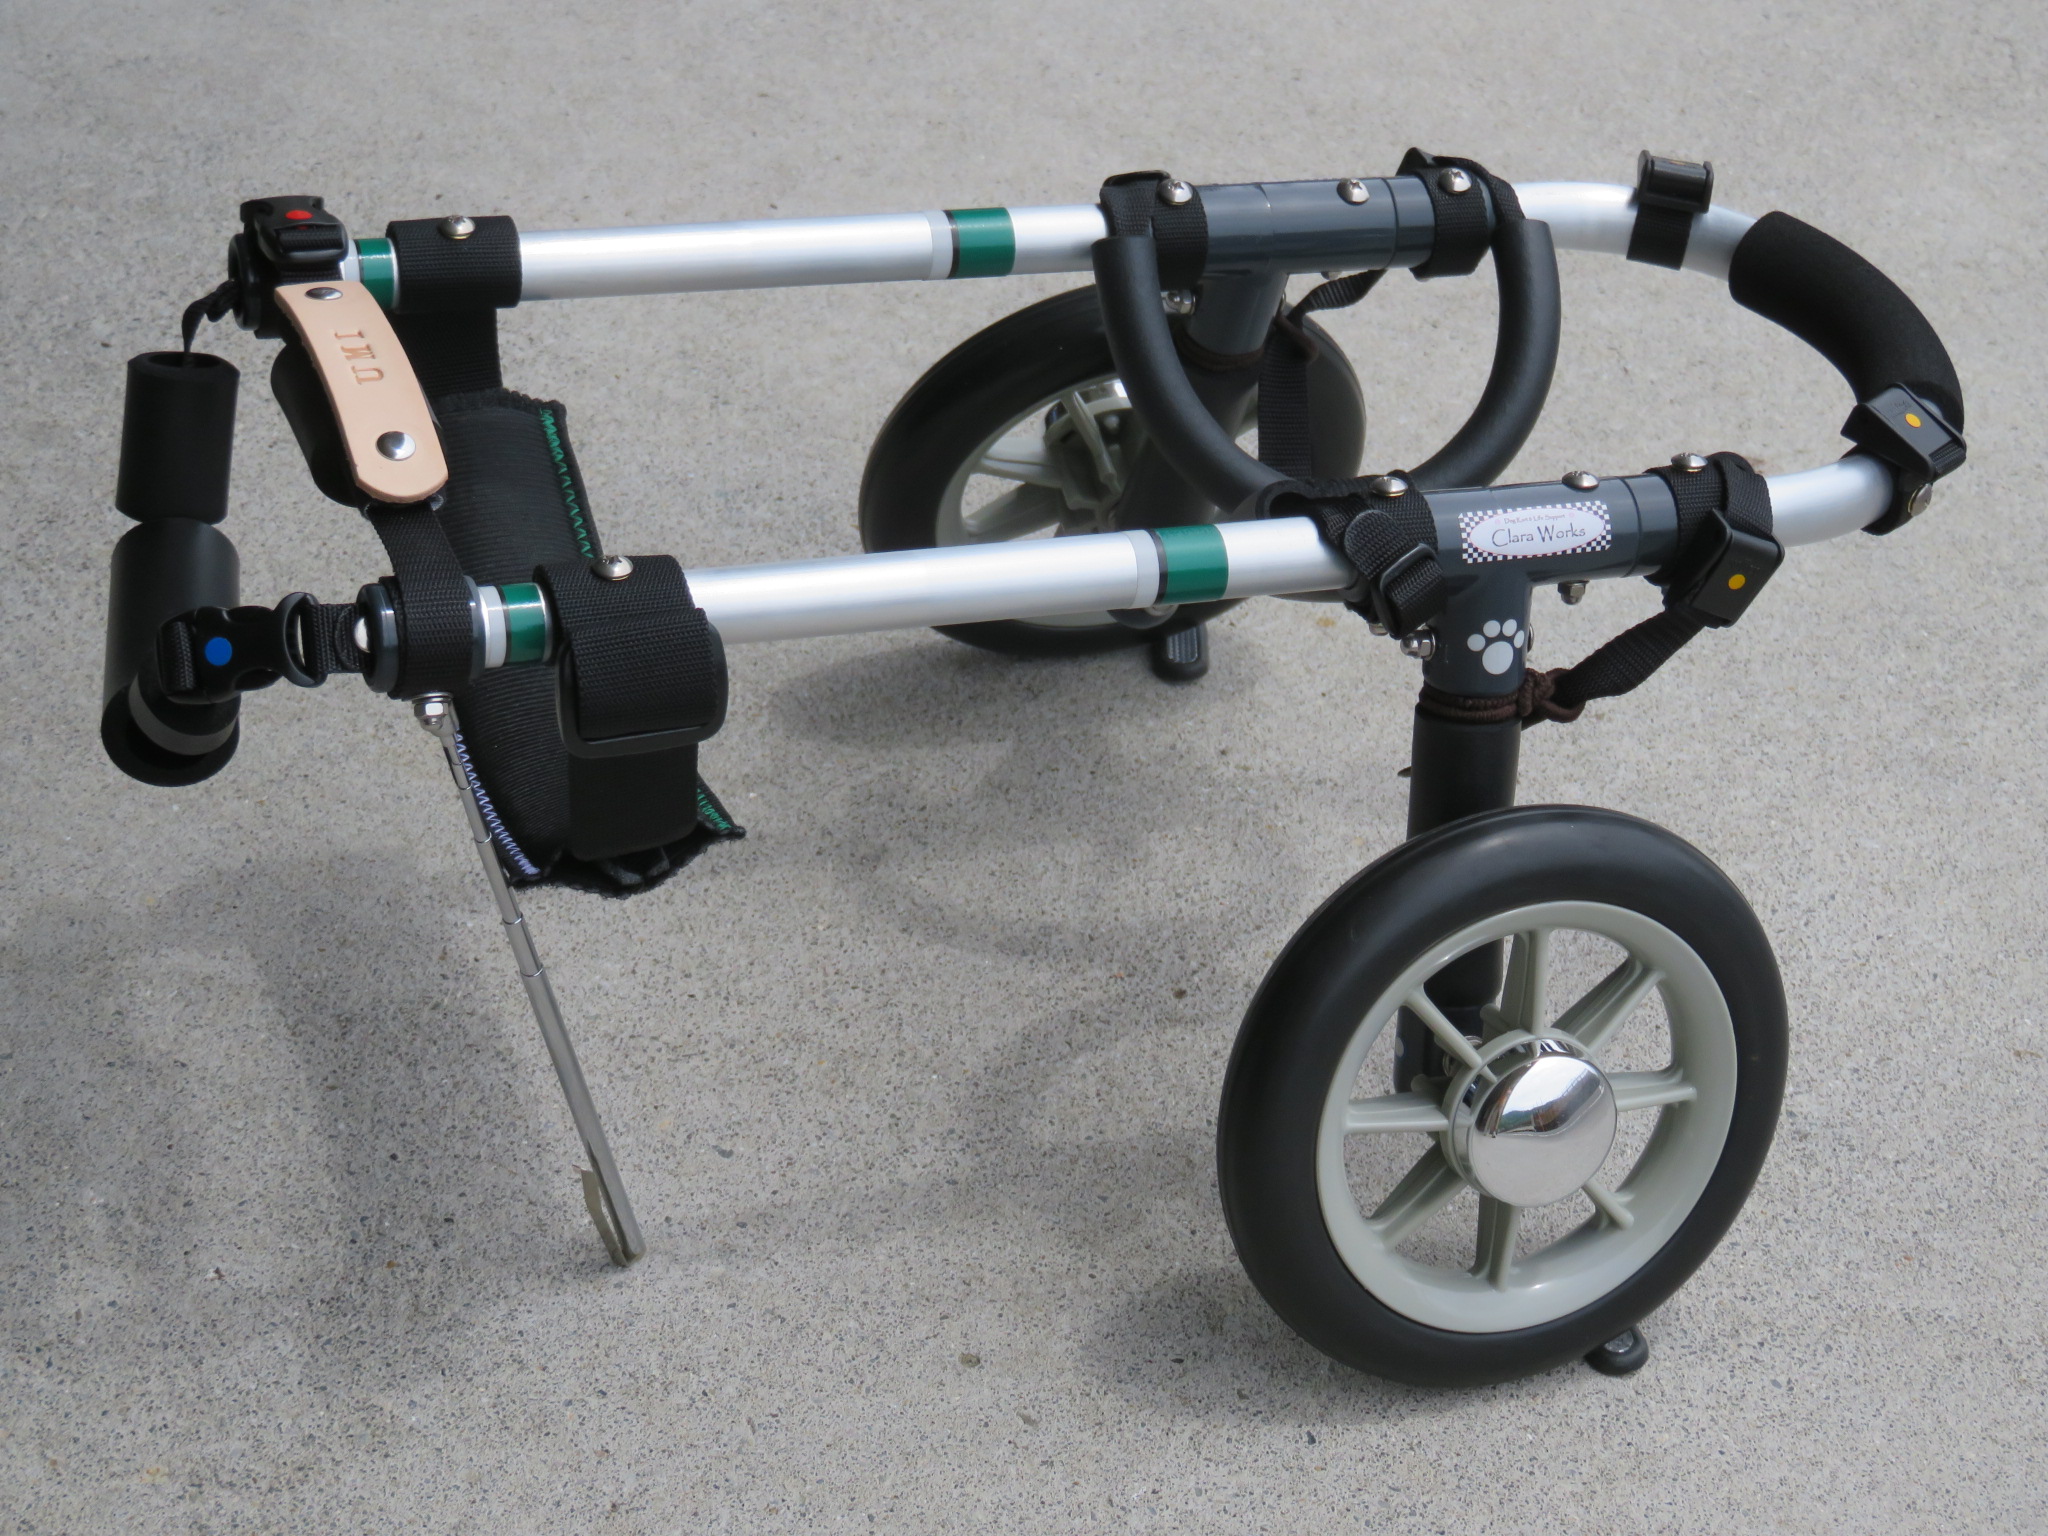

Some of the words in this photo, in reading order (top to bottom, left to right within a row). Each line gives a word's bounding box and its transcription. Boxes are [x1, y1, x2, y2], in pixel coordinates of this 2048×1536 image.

[334, 330, 385, 385] UMI
[1492, 528, 1534, 547] Clara
[1537, 523, 1586, 543] Works
